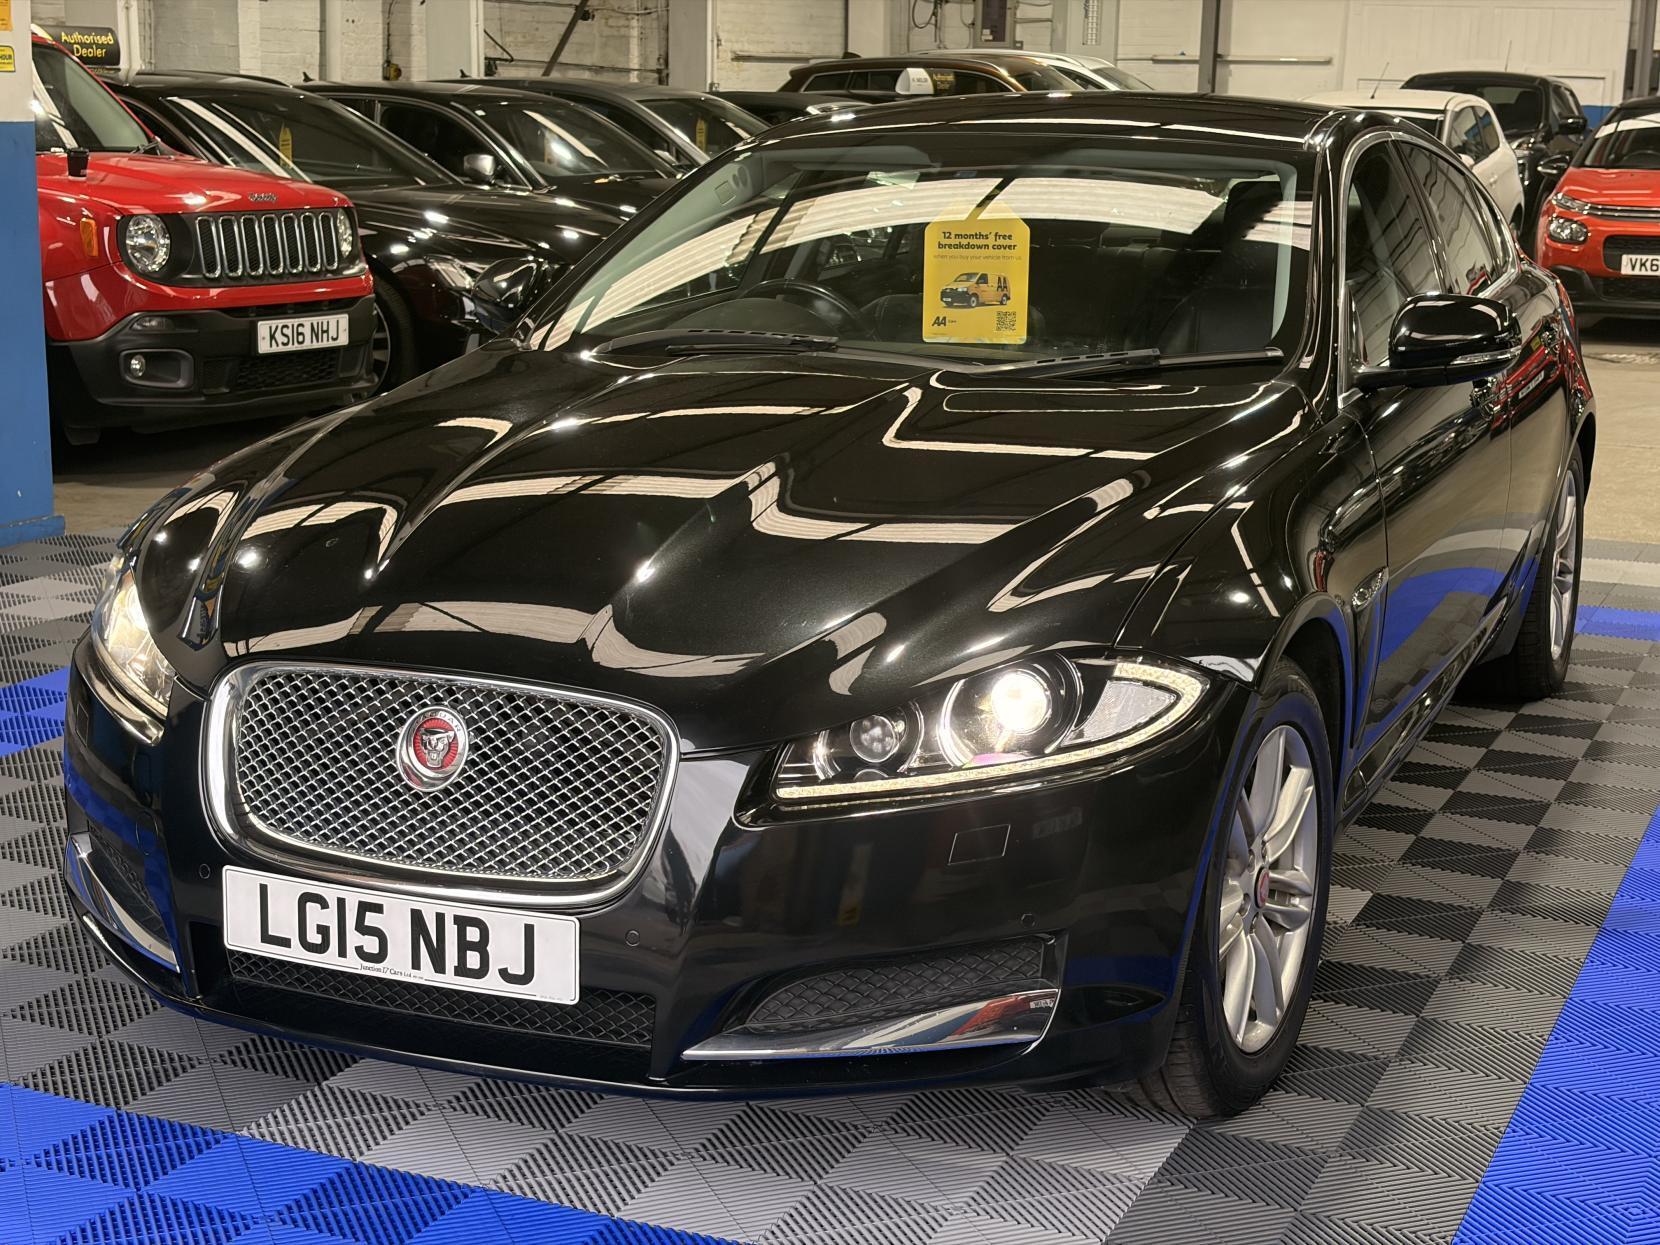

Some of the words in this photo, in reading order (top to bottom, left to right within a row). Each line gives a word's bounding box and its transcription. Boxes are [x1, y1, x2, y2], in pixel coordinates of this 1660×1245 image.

[61, 32, 114, 45] Authorised
[73, 45, 107, 57] Dealer
[942, 231, 952, 240] 12
[994, 231, 1013, 242] free
[938, 241, 989, 250] breakdown
[991, 243, 1018, 251] cover
[1629, 257, 1660, 272] VK6
[996, 276, 1008, 292] AA
[932, 316, 947, 327] AA
[269, 323, 306, 348] KS16
[310, 319, 340, 345] NHJ
[258, 883, 389, 965] LG15
[410, 907, 536, 986] NBJ
[360, 963, 382, 973] Junction
[389, 968, 403, 977] Cars
